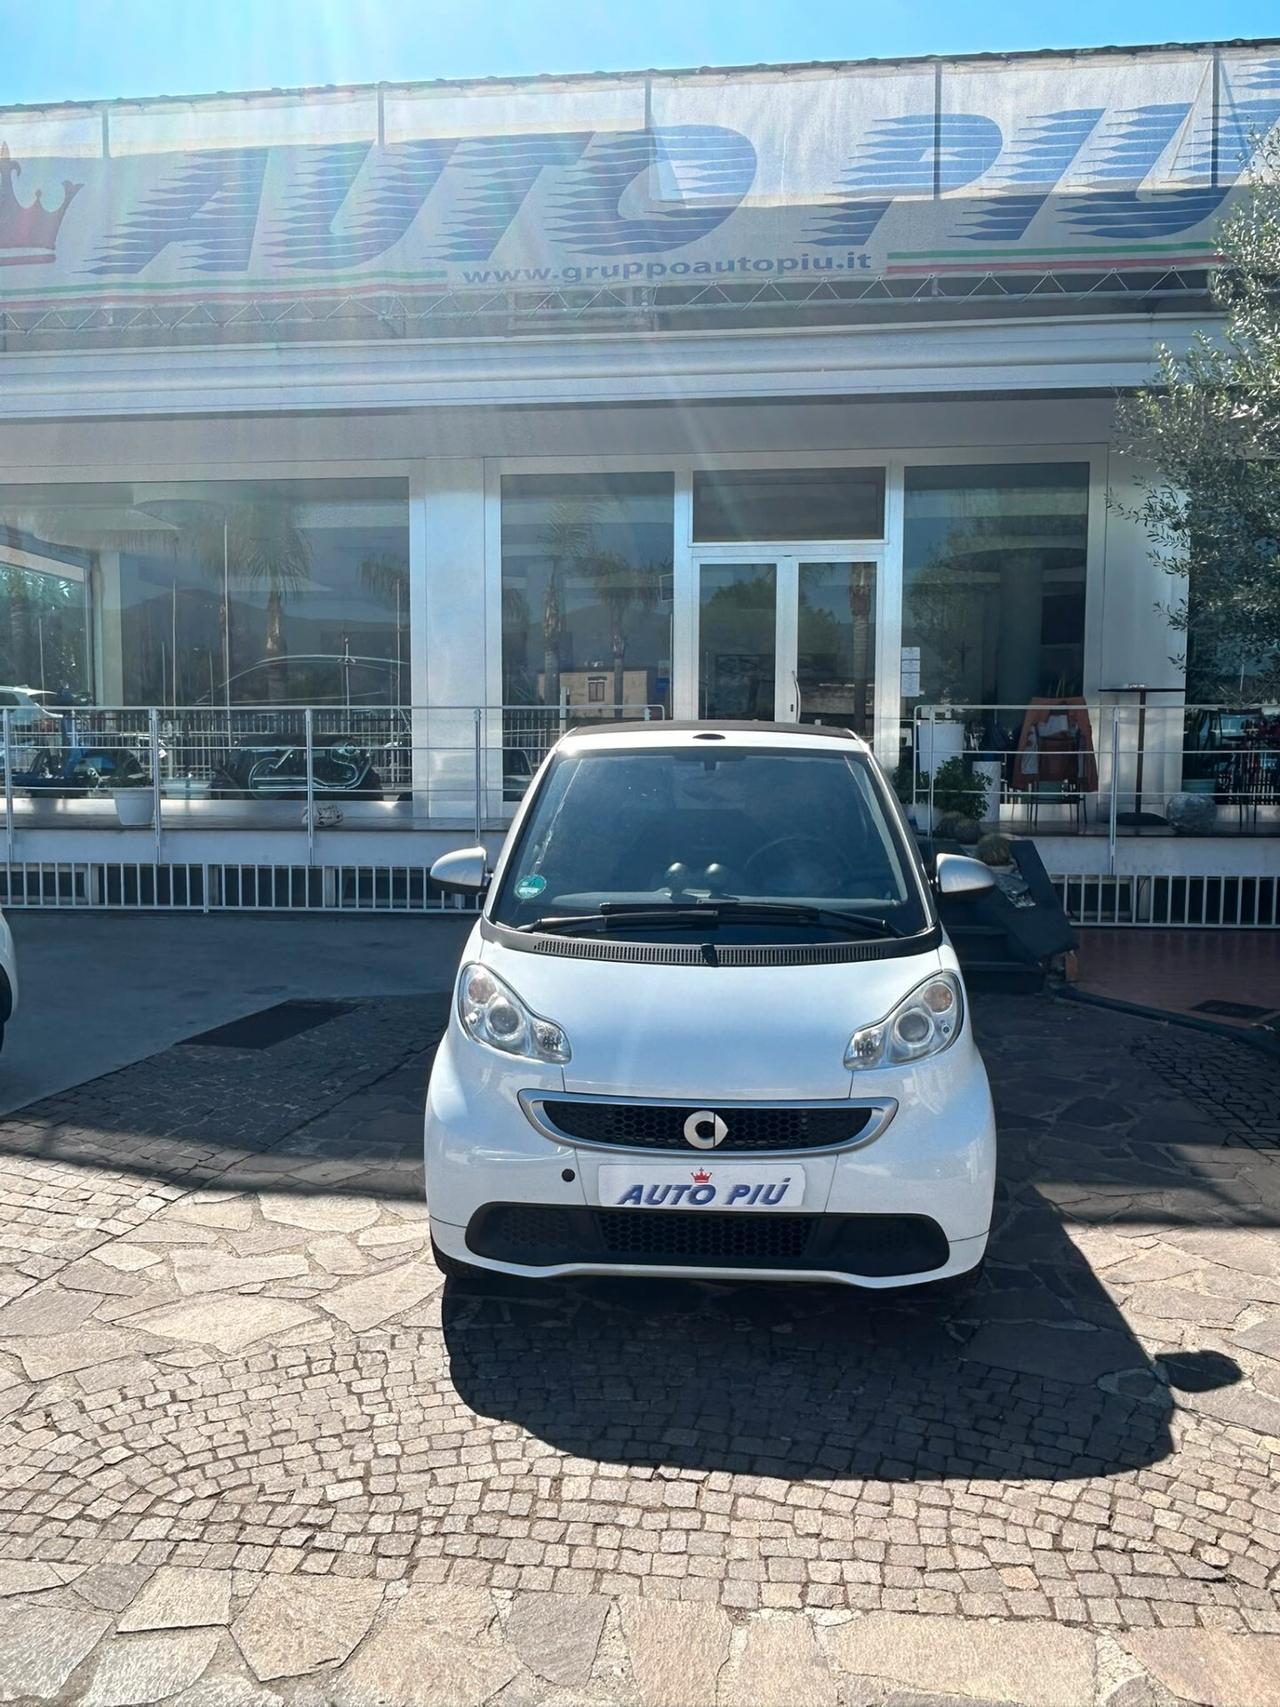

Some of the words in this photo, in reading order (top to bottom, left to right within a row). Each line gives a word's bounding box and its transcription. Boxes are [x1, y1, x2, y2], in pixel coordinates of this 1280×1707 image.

[74, 124, 757, 274] AUTO
[463, 252, 871, 285] www.gruppoautopiu.it
[616, 1184, 716, 1206] AUTO
